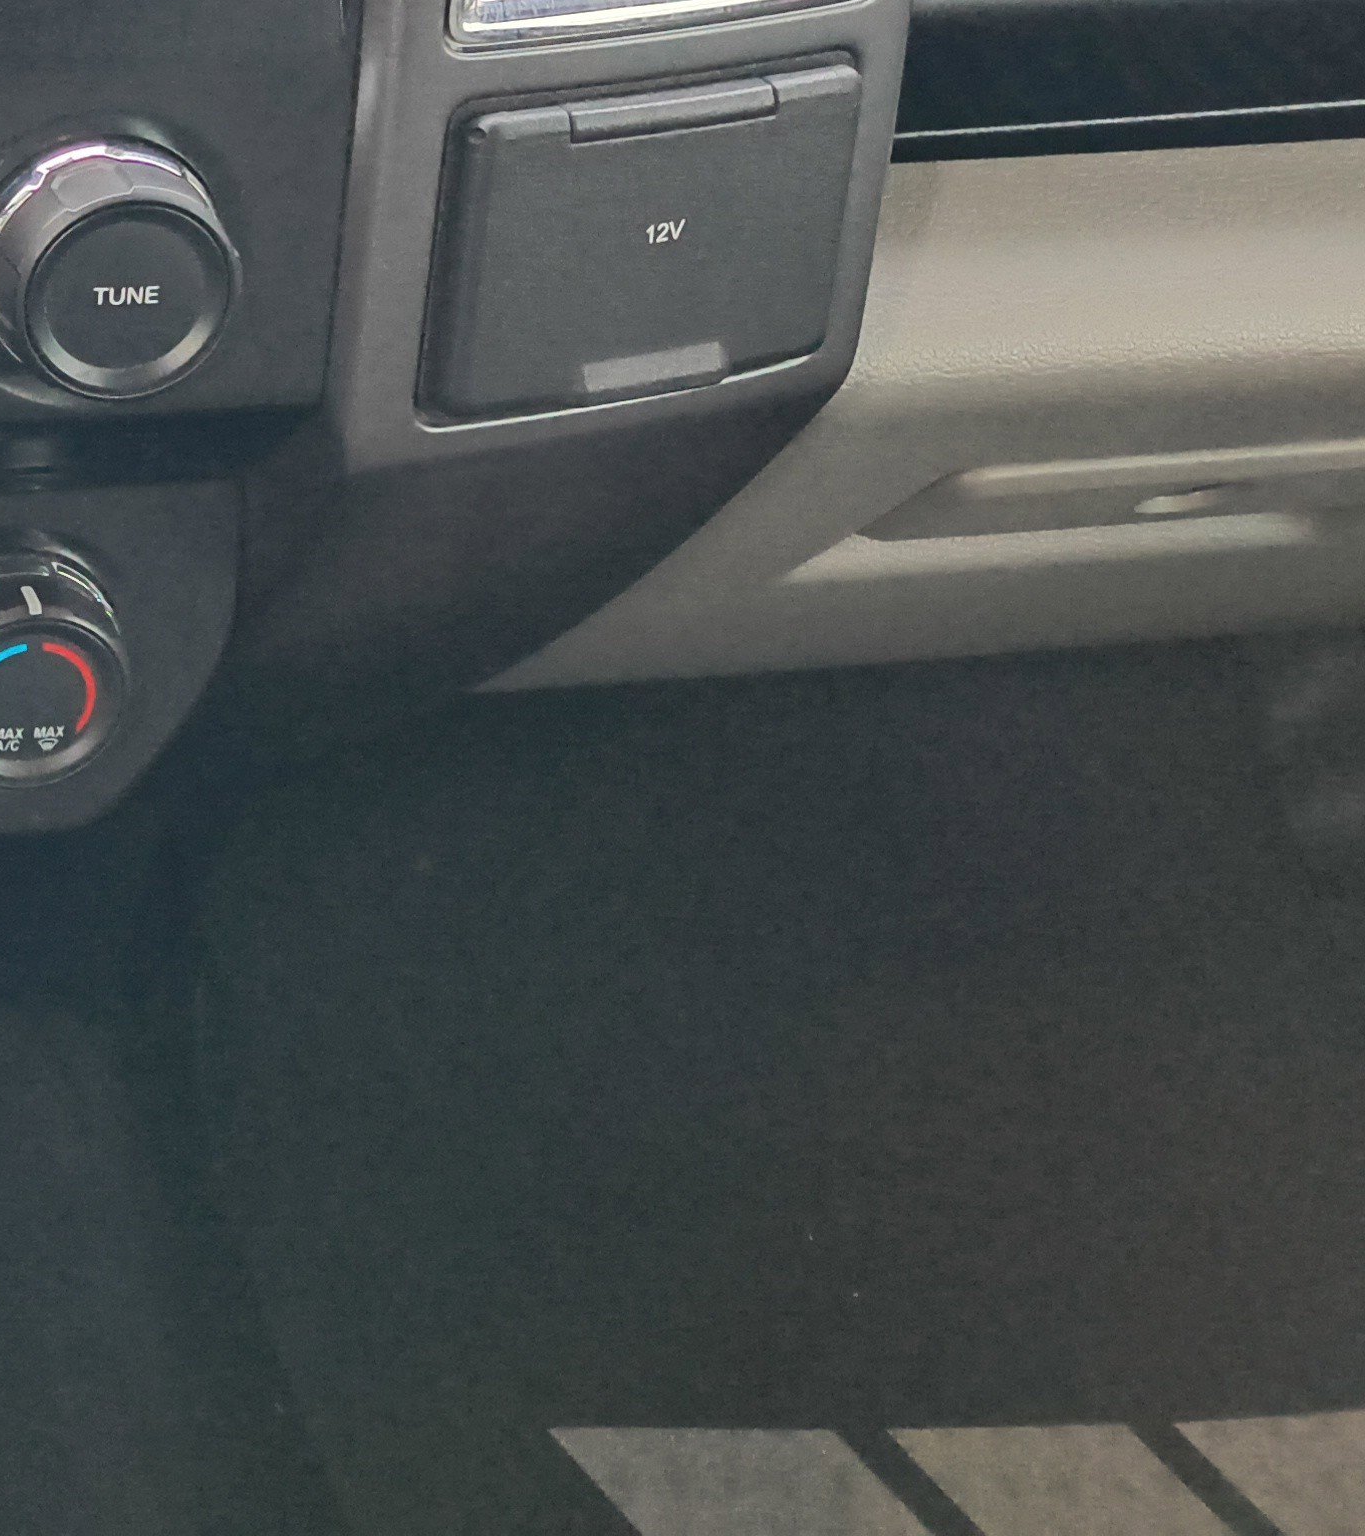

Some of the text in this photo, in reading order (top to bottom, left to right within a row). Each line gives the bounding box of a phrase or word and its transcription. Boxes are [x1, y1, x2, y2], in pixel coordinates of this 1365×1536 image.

[645, 218, 687, 245] 12V
[92, 284, 160, 306] TUNE
[33, 725, 65, 739] MAX
